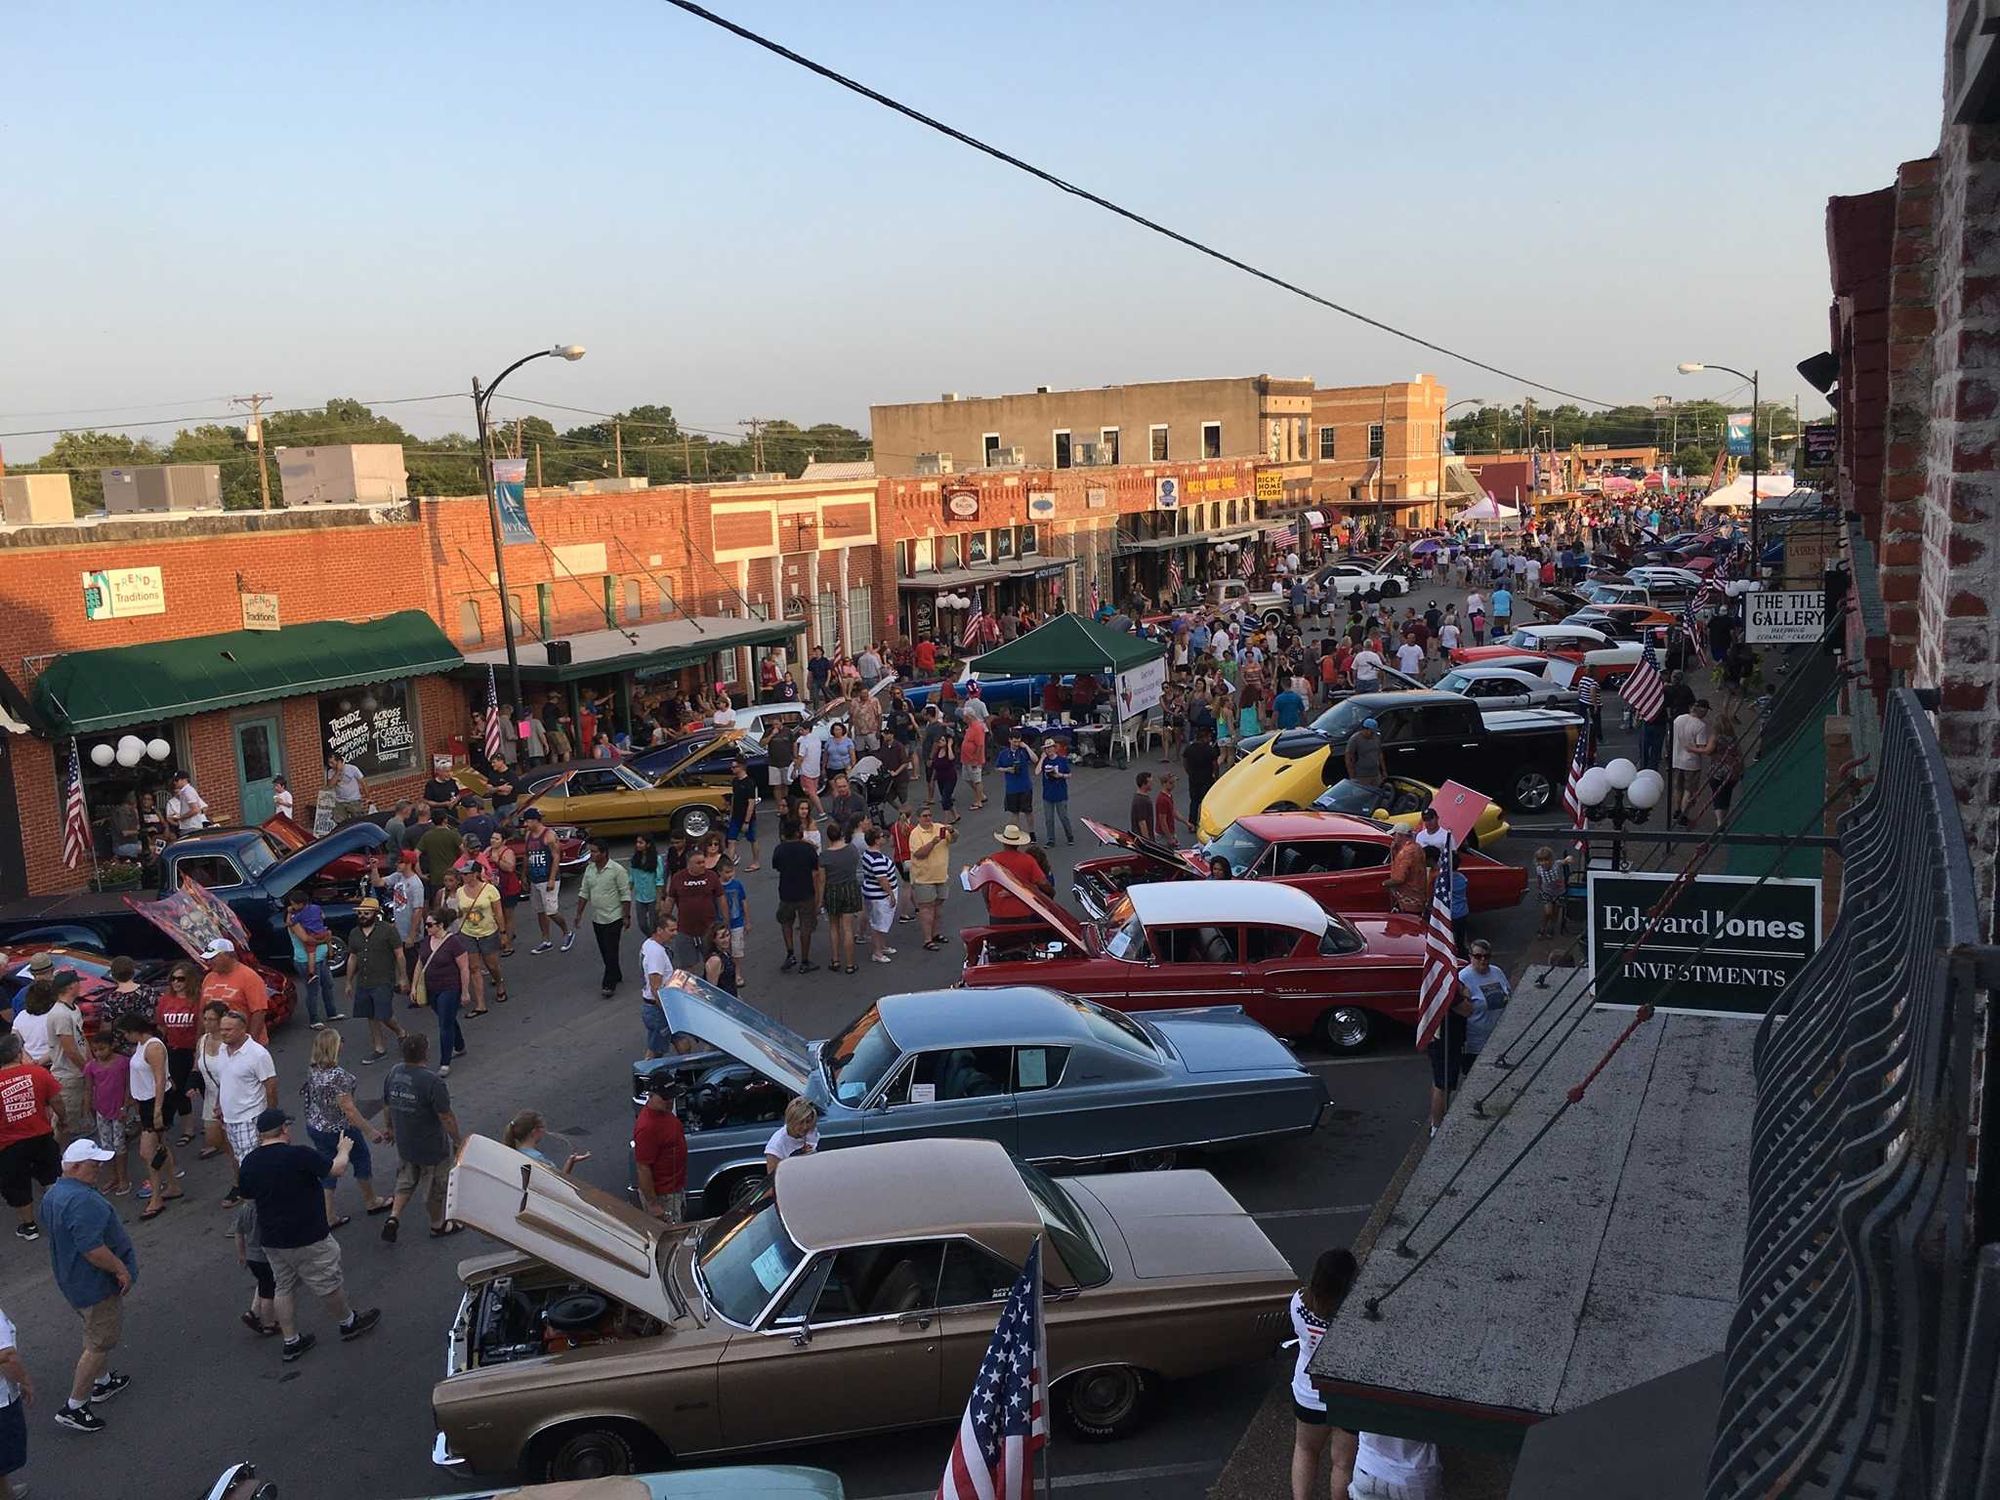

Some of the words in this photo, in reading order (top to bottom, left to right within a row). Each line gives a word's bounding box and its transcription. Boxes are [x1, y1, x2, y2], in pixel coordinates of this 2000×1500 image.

[1258, 475, 1282, 483] RICK'S
[114, 573, 159, 592] TRENDZ
[115, 592, 160, 604] Traditions
[1754, 594, 1783, 609] THE
[1788, 594, 1825, 609] TILE
[1752, 610, 1825, 626] GALLERY
[328, 710, 361, 733] TRENDZ
[373, 707, 401, 722] ACROSS
[328, 722, 369, 749] Traditions
[380, 724, 412, 738] CARROLL
[381, 733, 414, 748] JEWELRY
[1603, 905, 1710, 935] Edward
[1714, 910, 1806, 940] Jones
[1624, 961, 1786, 987] INVESTMENTS
